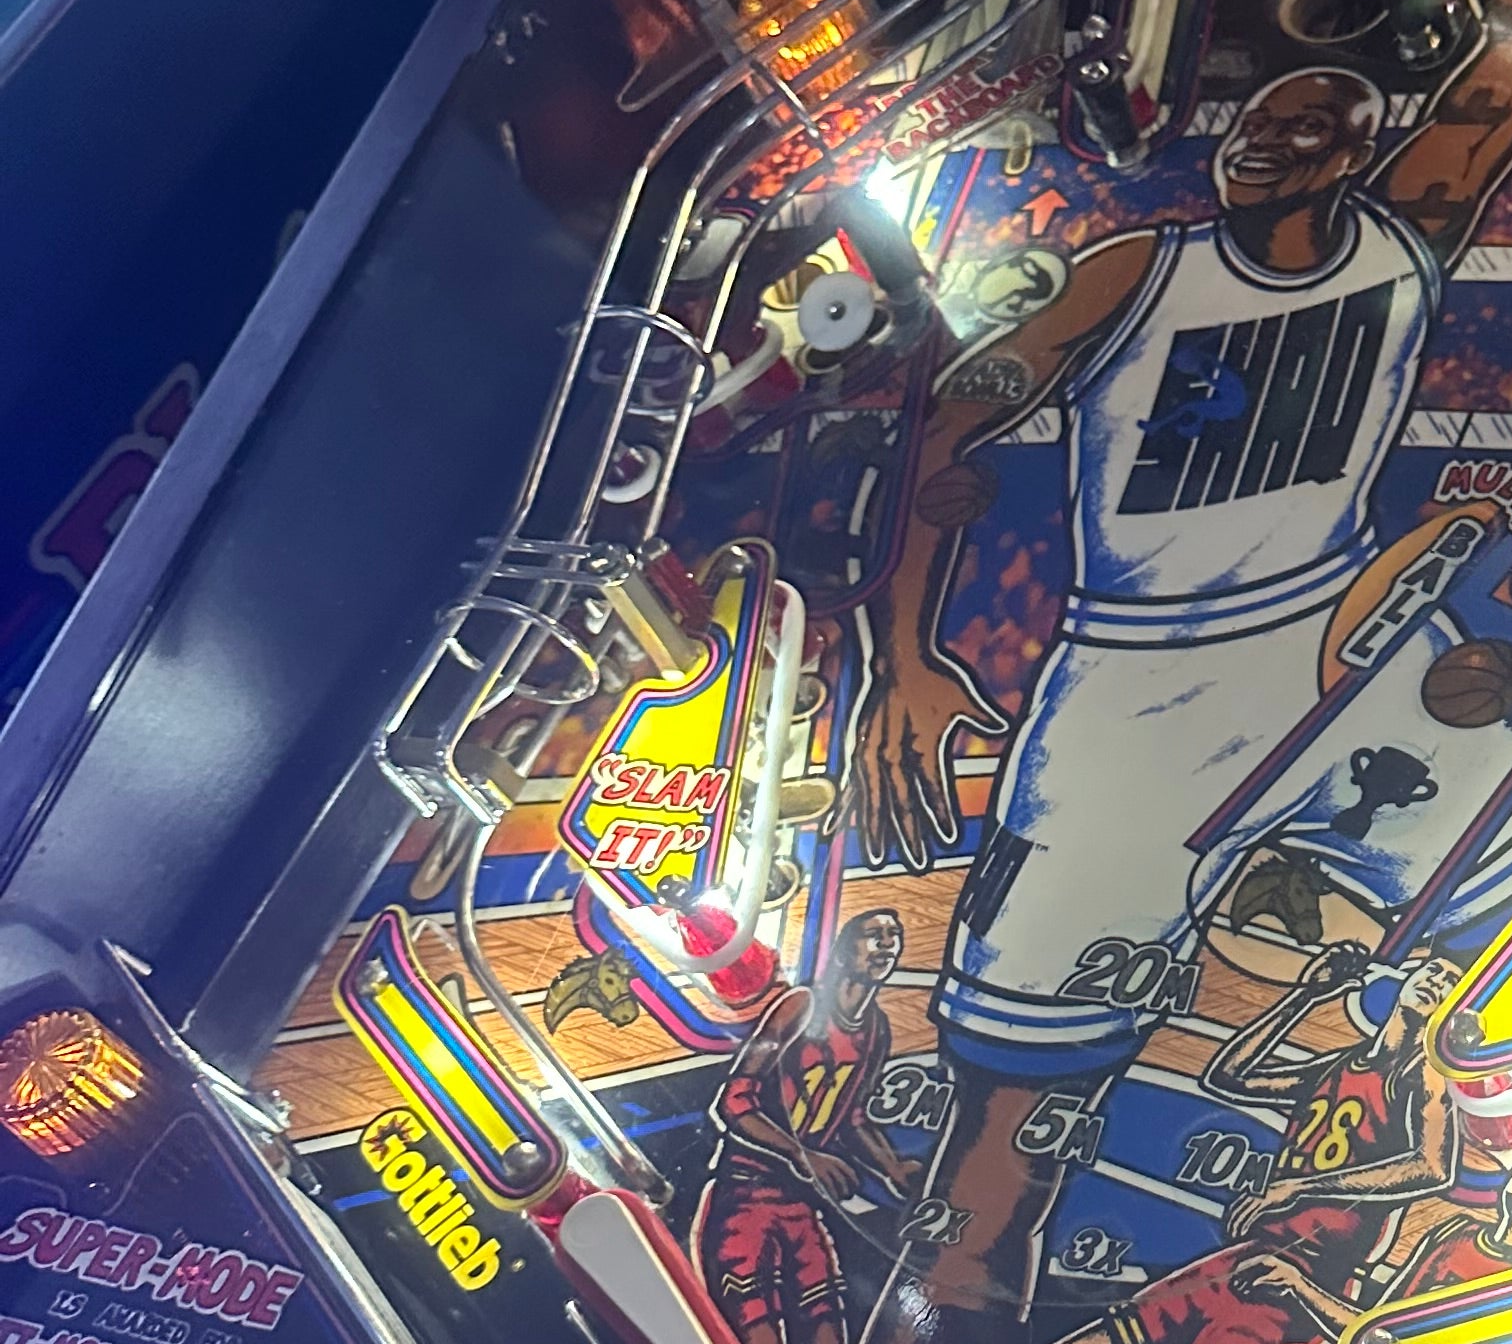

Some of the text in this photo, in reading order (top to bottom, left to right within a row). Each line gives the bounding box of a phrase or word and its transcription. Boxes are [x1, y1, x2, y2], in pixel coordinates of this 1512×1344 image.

[1337, 517, 1485, 668] BALL
[1056, 937, 1202, 1016] 20M
[866, 1066, 956, 1132] 3M
[1012, 1093, 1106, 1166] 5M
[1177, 1128, 1280, 1195] 10M
[359, 1109, 502, 1292] Gottlieb
[0, 1208, 304, 1331] SUPER-MODE
[1061, 1227, 1132, 1277] 3X
